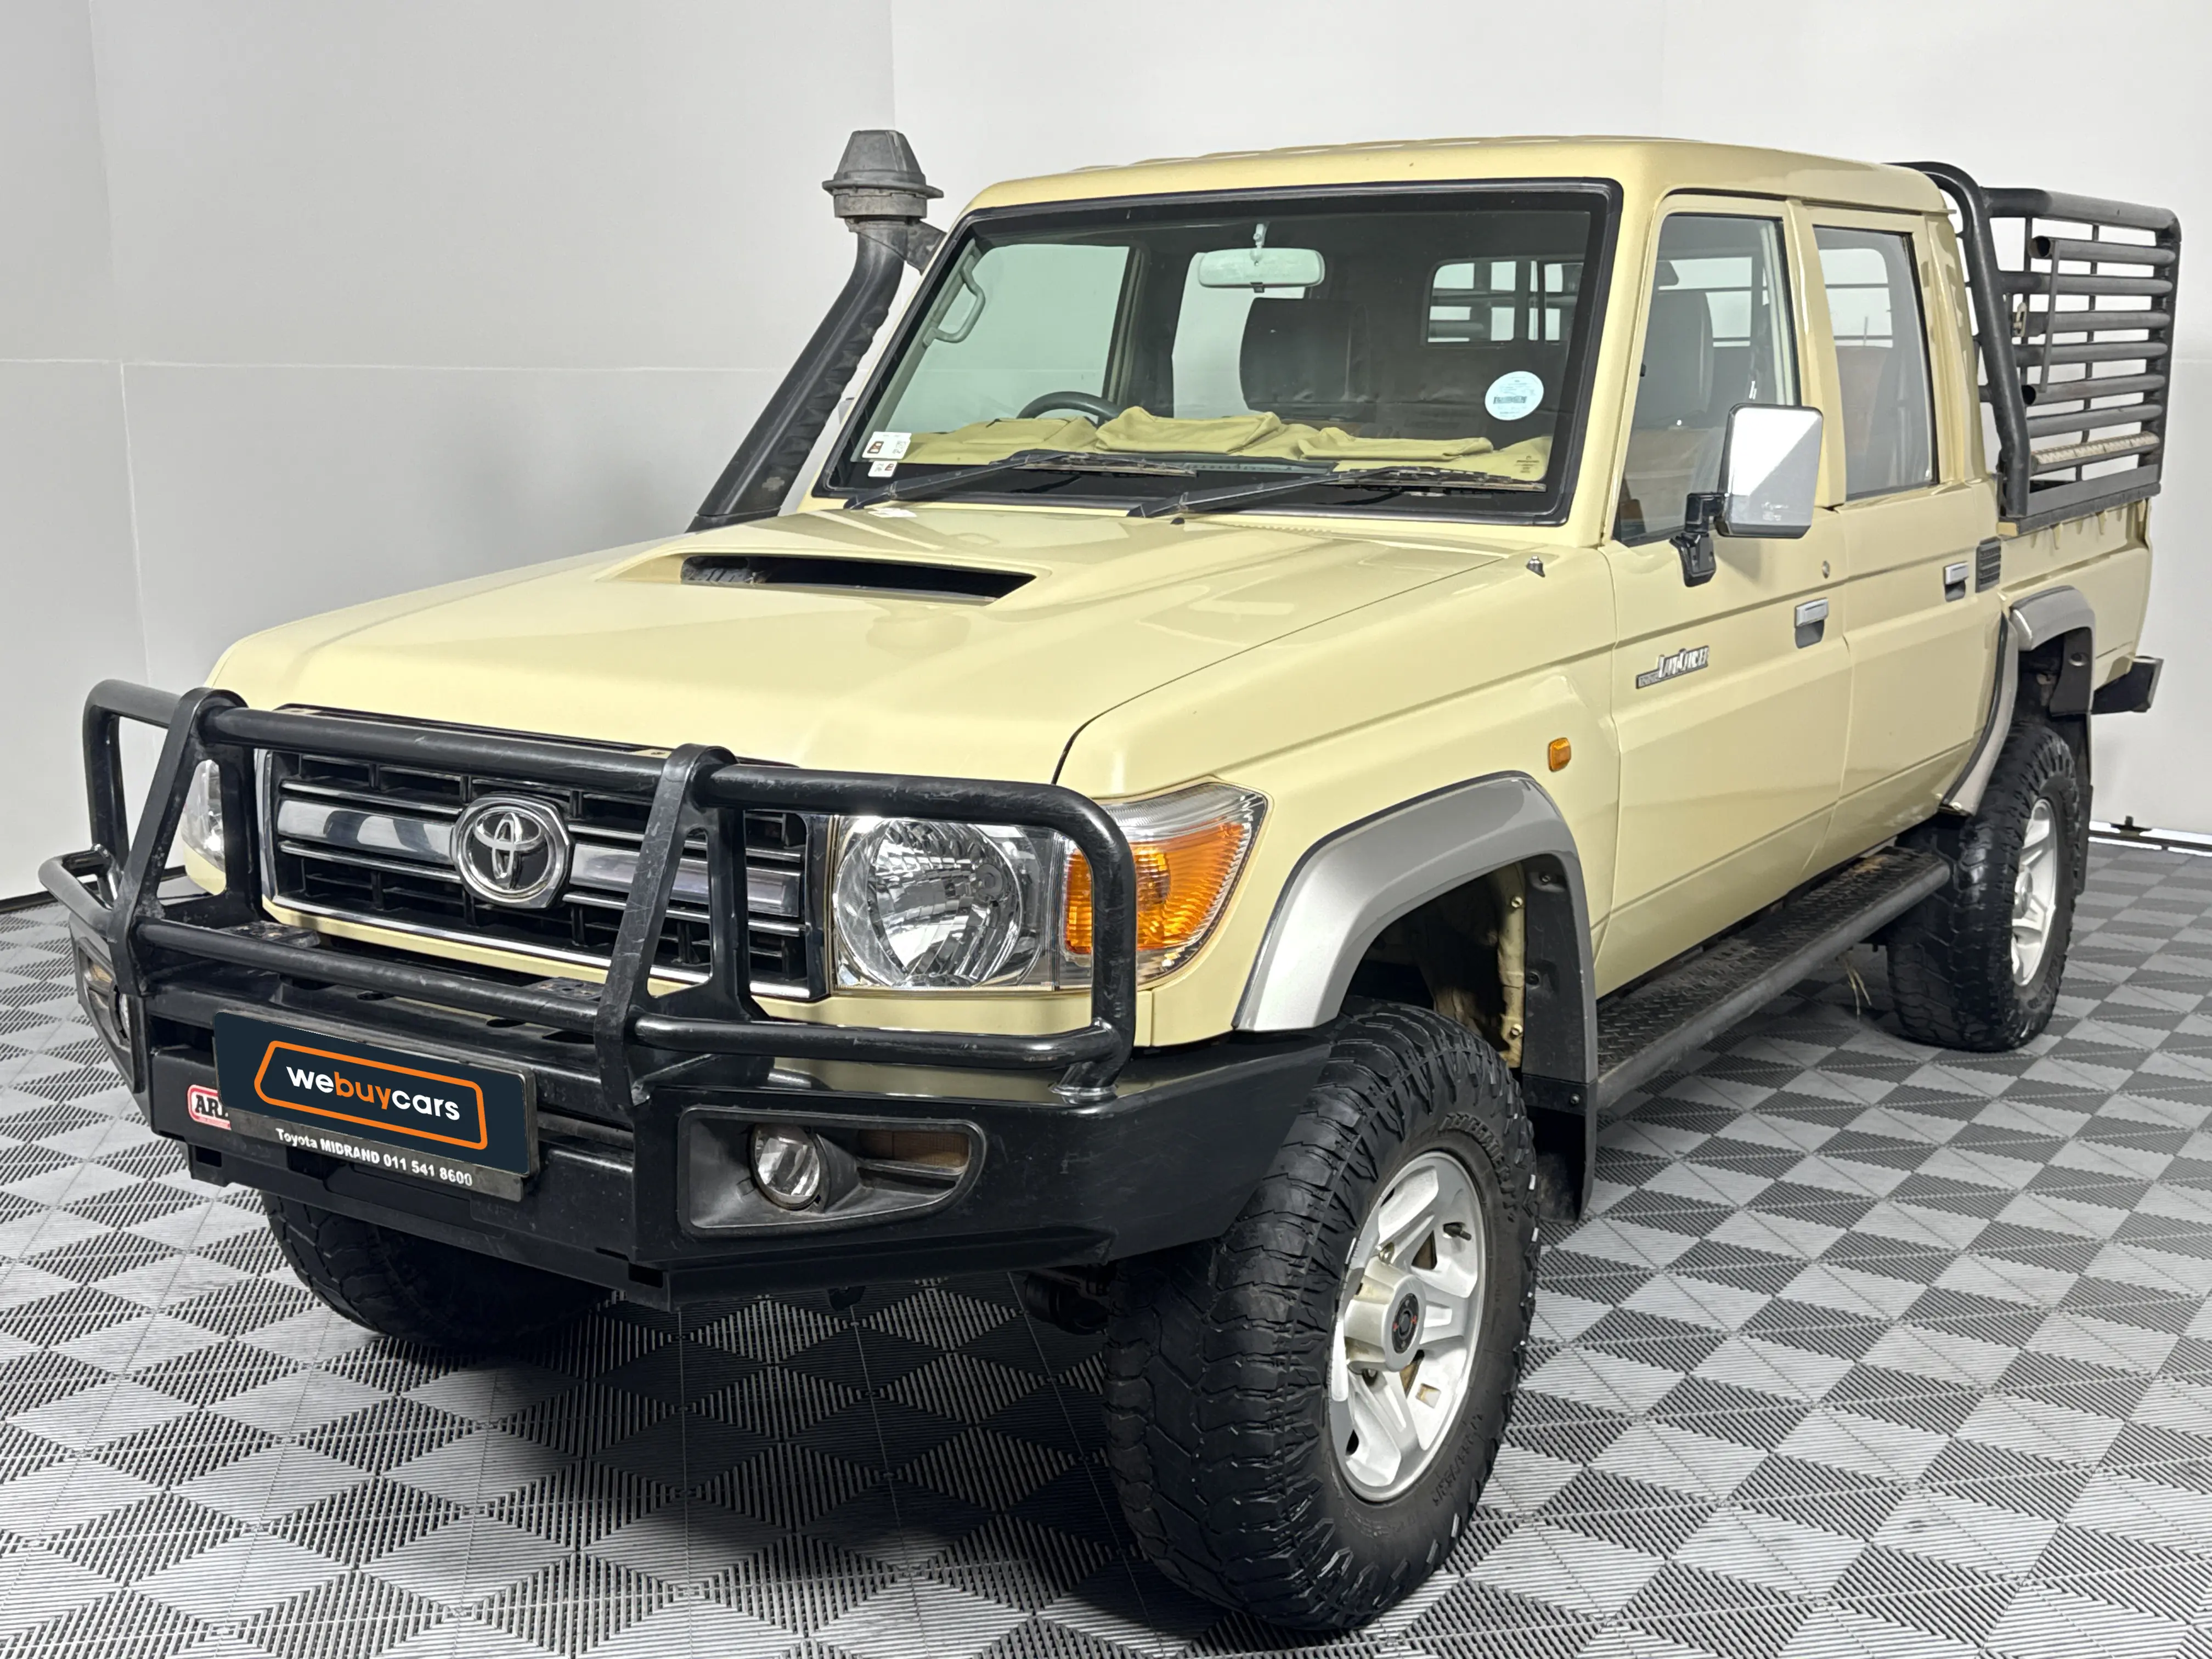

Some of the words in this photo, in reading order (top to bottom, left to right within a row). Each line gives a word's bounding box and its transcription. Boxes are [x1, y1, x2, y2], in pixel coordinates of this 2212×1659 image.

[275, 1128, 318, 1149] Toyota
[320, 1138, 380, 1164] MIDRAND
[383, 1153, 407, 1171] 011
[411, 1160, 435, 1177] 541
[439, 1167, 472, 1186] 8600
